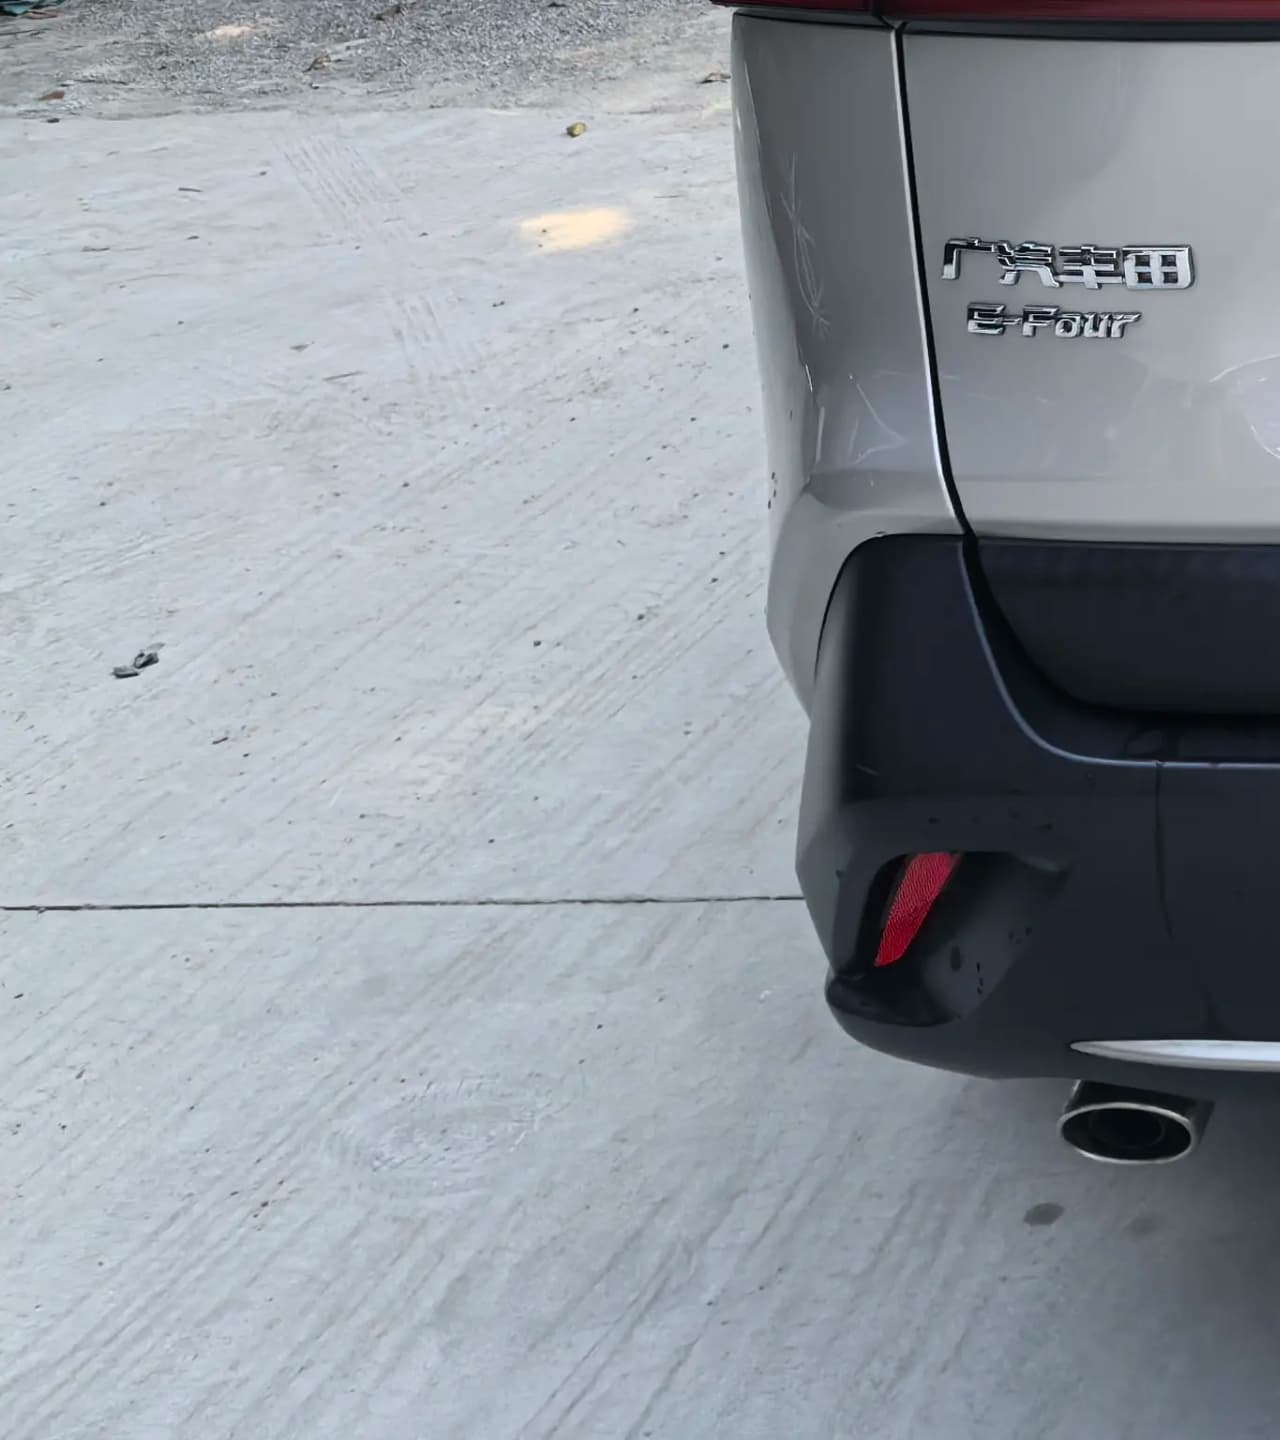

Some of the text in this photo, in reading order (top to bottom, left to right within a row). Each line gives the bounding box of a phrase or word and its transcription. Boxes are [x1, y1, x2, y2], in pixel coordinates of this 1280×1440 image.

[941, 237, 1195, 290] 广汽丰田
[967, 302, 1142, 338] E-Four
